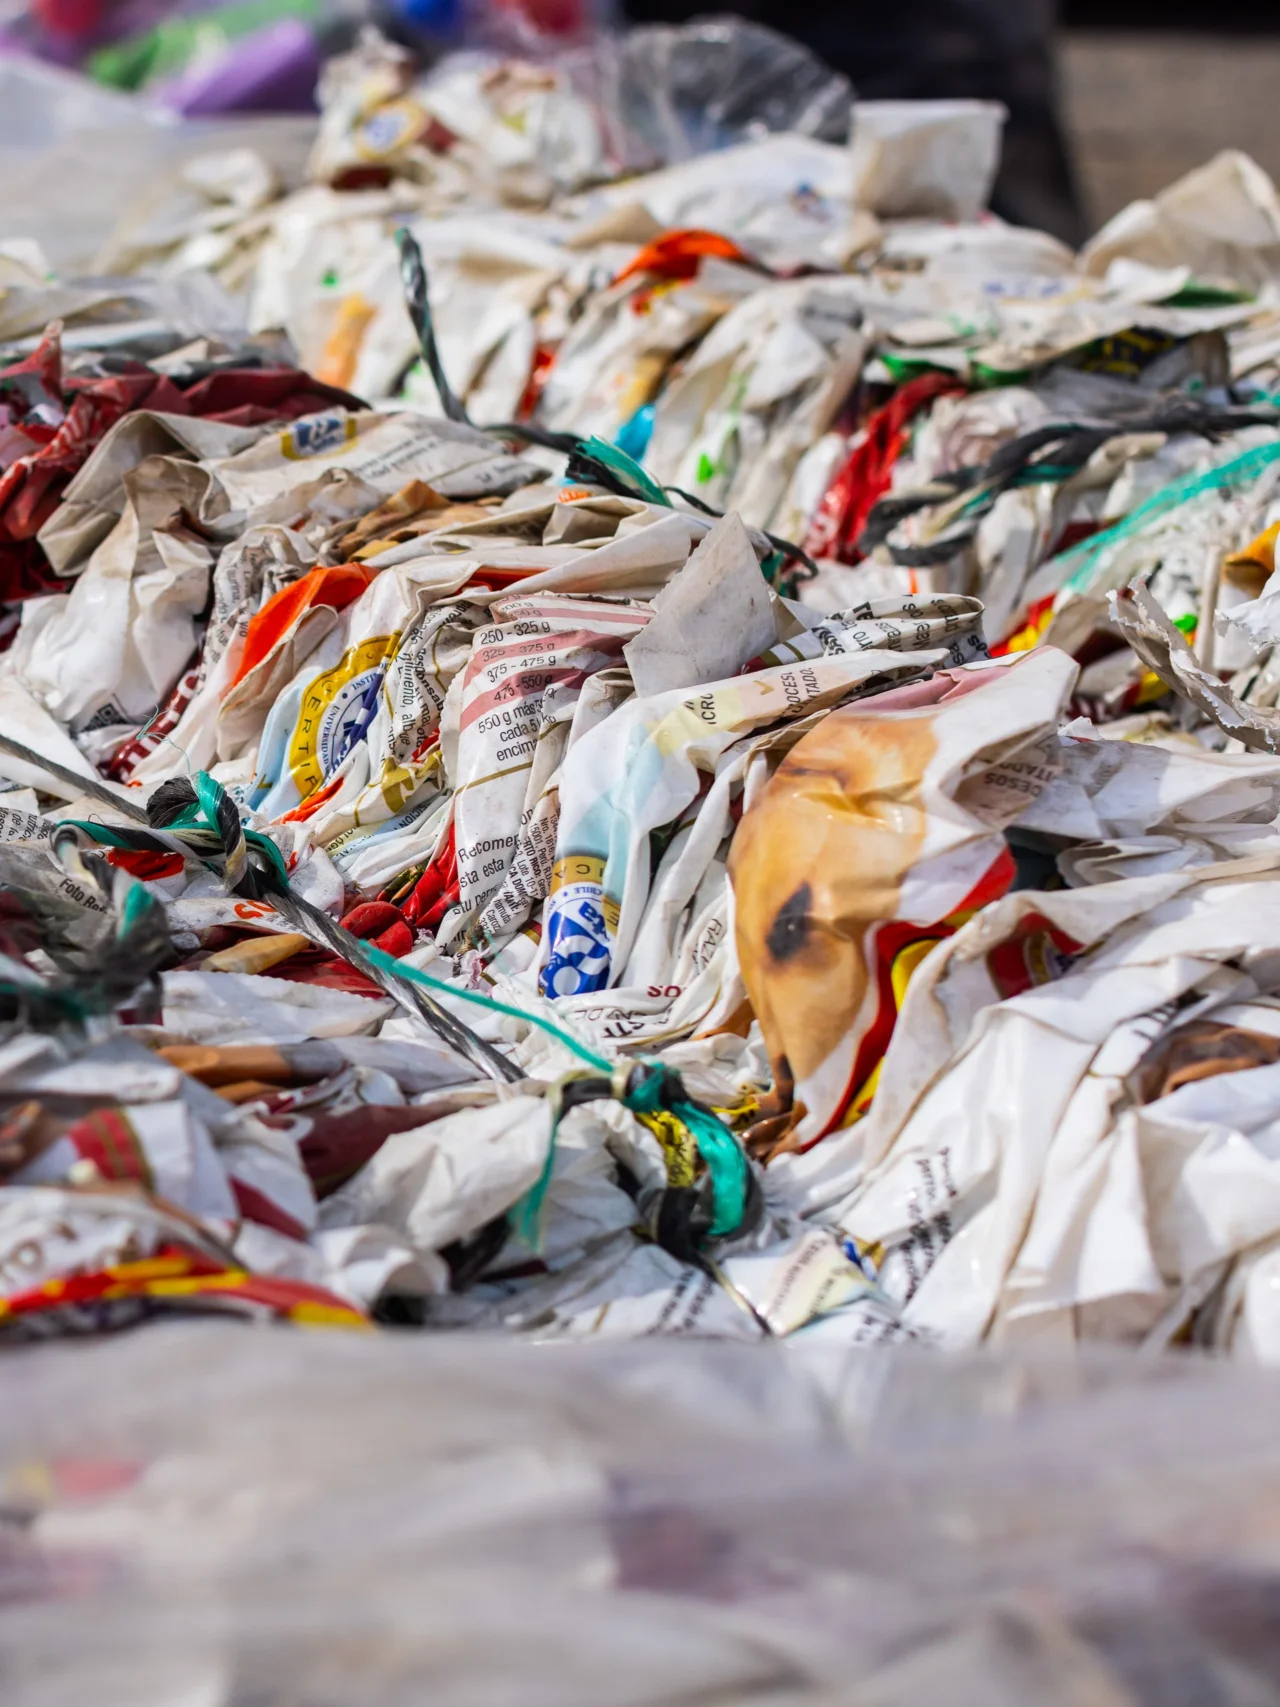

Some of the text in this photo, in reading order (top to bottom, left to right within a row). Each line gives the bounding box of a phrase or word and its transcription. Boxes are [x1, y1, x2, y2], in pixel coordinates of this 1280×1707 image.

[480, 628, 504, 645] 250
[513, 620, 539, 637] 325
[541, 621, 551, 633] g
[482, 647, 506, 663] 325
[518, 642, 544, 653] 375
[546, 642, 556, 651] g
[486, 662, 508, 683] 375
[520, 656, 545, 668] 475
[548, 655, 557, 667] g
[493, 682, 515, 701] 475
[521, 674, 542, 690] 550
[478, 713, 501, 734] 550
[502, 711, 512, 726] g
[513, 701, 536, 719] más
[499, 723, 530, 742] cada
[496, 739, 538, 762] encima
[540, 816, 550, 834] Nro.
[459, 858, 505, 890] sta esta
[516, 859, 531, 877] Lote
[529, 857, 542, 879] RICO:
[59, 877, 85, 902] Foto
